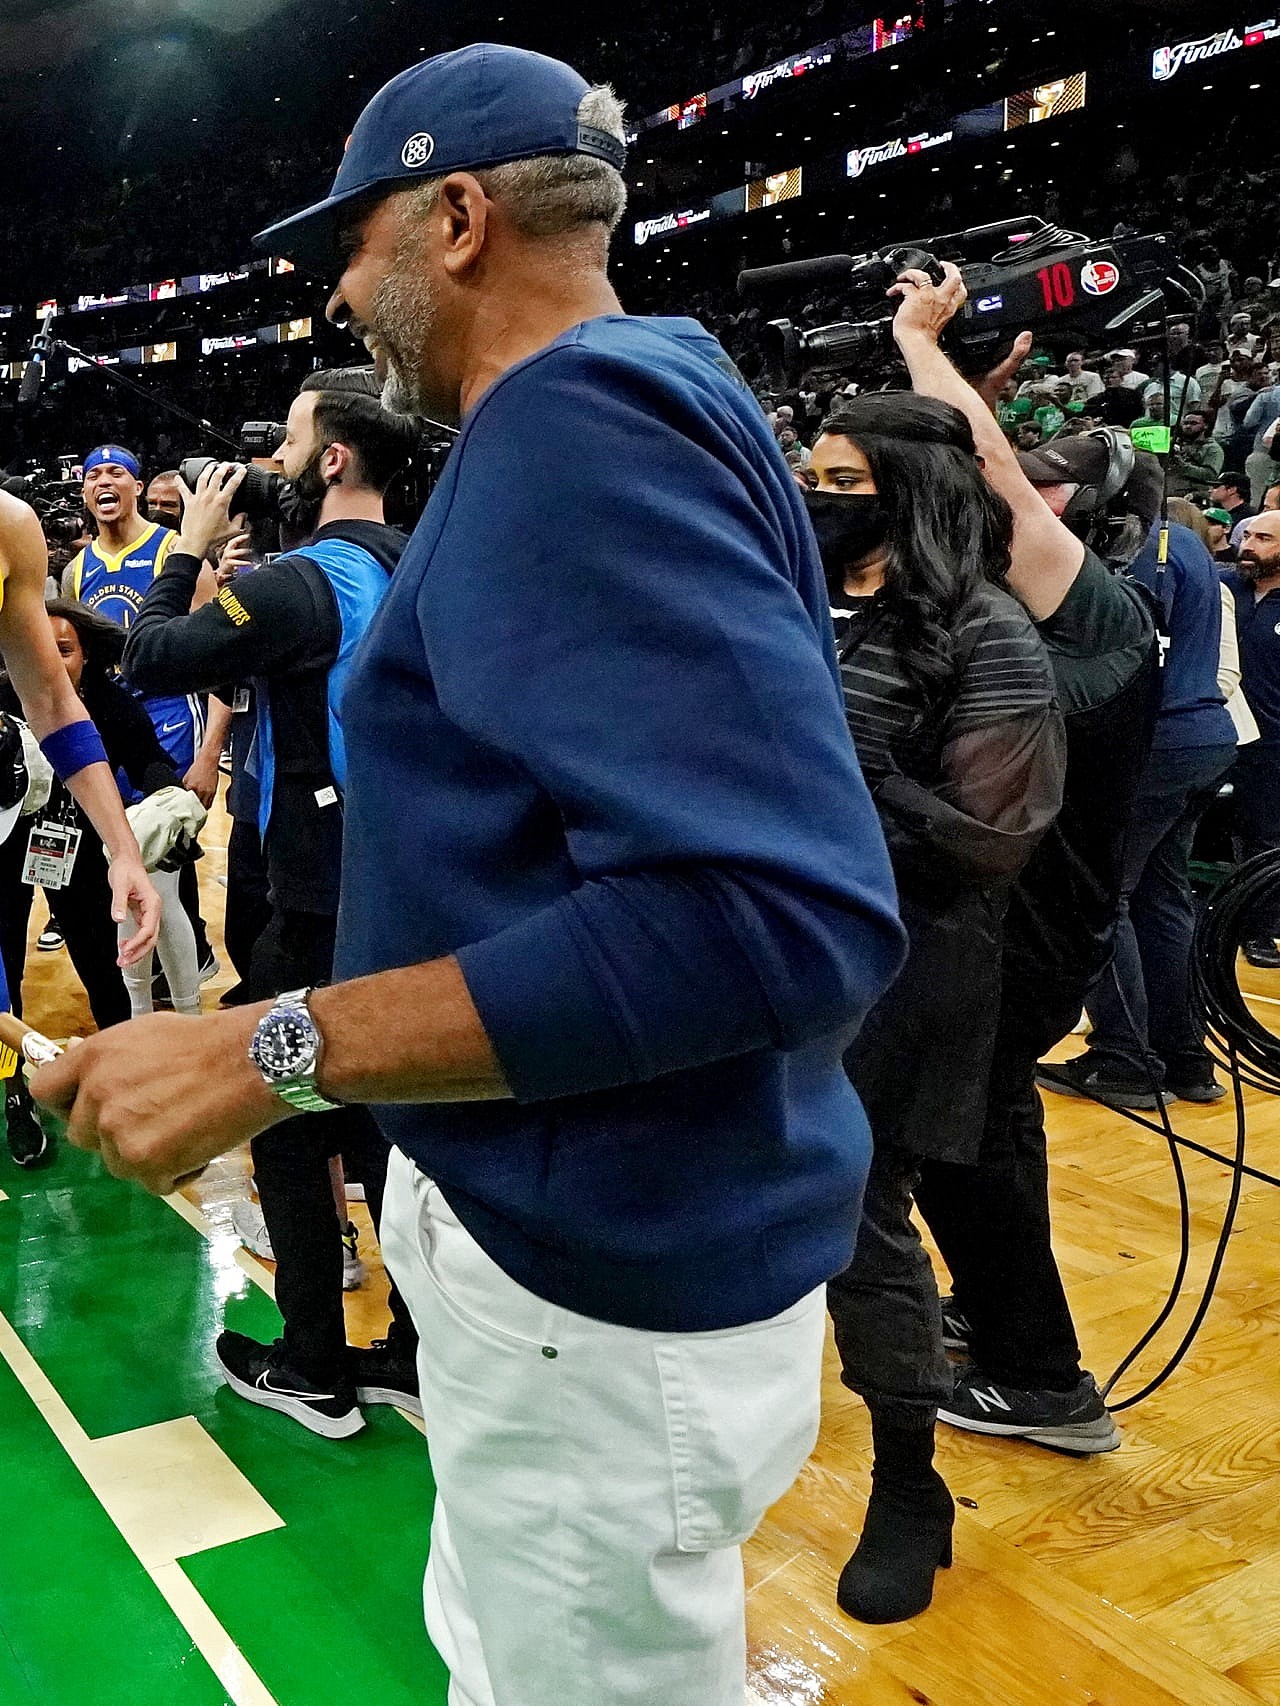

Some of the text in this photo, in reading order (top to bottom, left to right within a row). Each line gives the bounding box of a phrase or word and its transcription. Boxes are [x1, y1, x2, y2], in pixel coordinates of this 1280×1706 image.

[1160, 28, 1243, 81] Finals
[852, 138, 907, 178] Finals
[639, 213, 678, 245] Finals
[1038, 262, 1074, 311] 10
[1045, 449, 1068, 464] ESPN
[87, 585, 144, 607] OLDEN STATE
